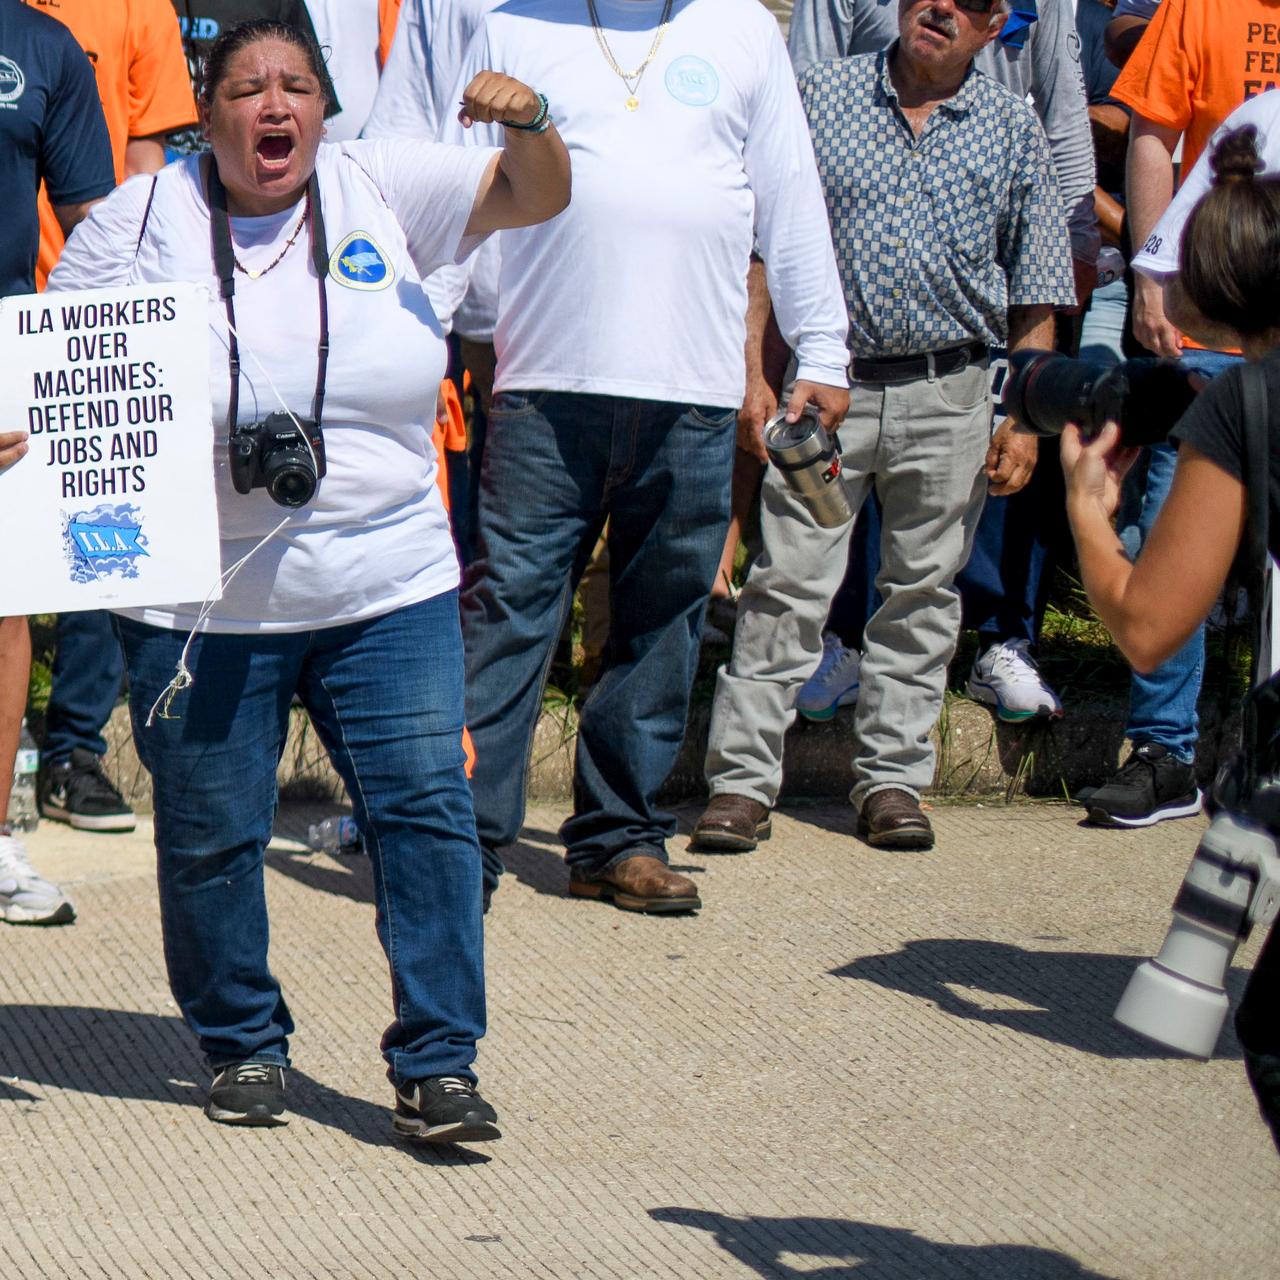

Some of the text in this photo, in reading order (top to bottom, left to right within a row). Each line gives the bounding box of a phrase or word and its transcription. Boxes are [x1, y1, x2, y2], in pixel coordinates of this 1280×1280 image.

[1247, 22, 1280, 45] PE
[18, 296, 176, 335] ILA WORKERS
[66, 332, 127, 362] OVER
[33, 362, 163, 400] MACHINES:
[28, 393, 174, 435] DEFEND OUR
[46, 429, 158, 466] JOBS AND
[61, 464, 146, 498] RIGHTS
[81, 530, 133, 553] I.L.A.
